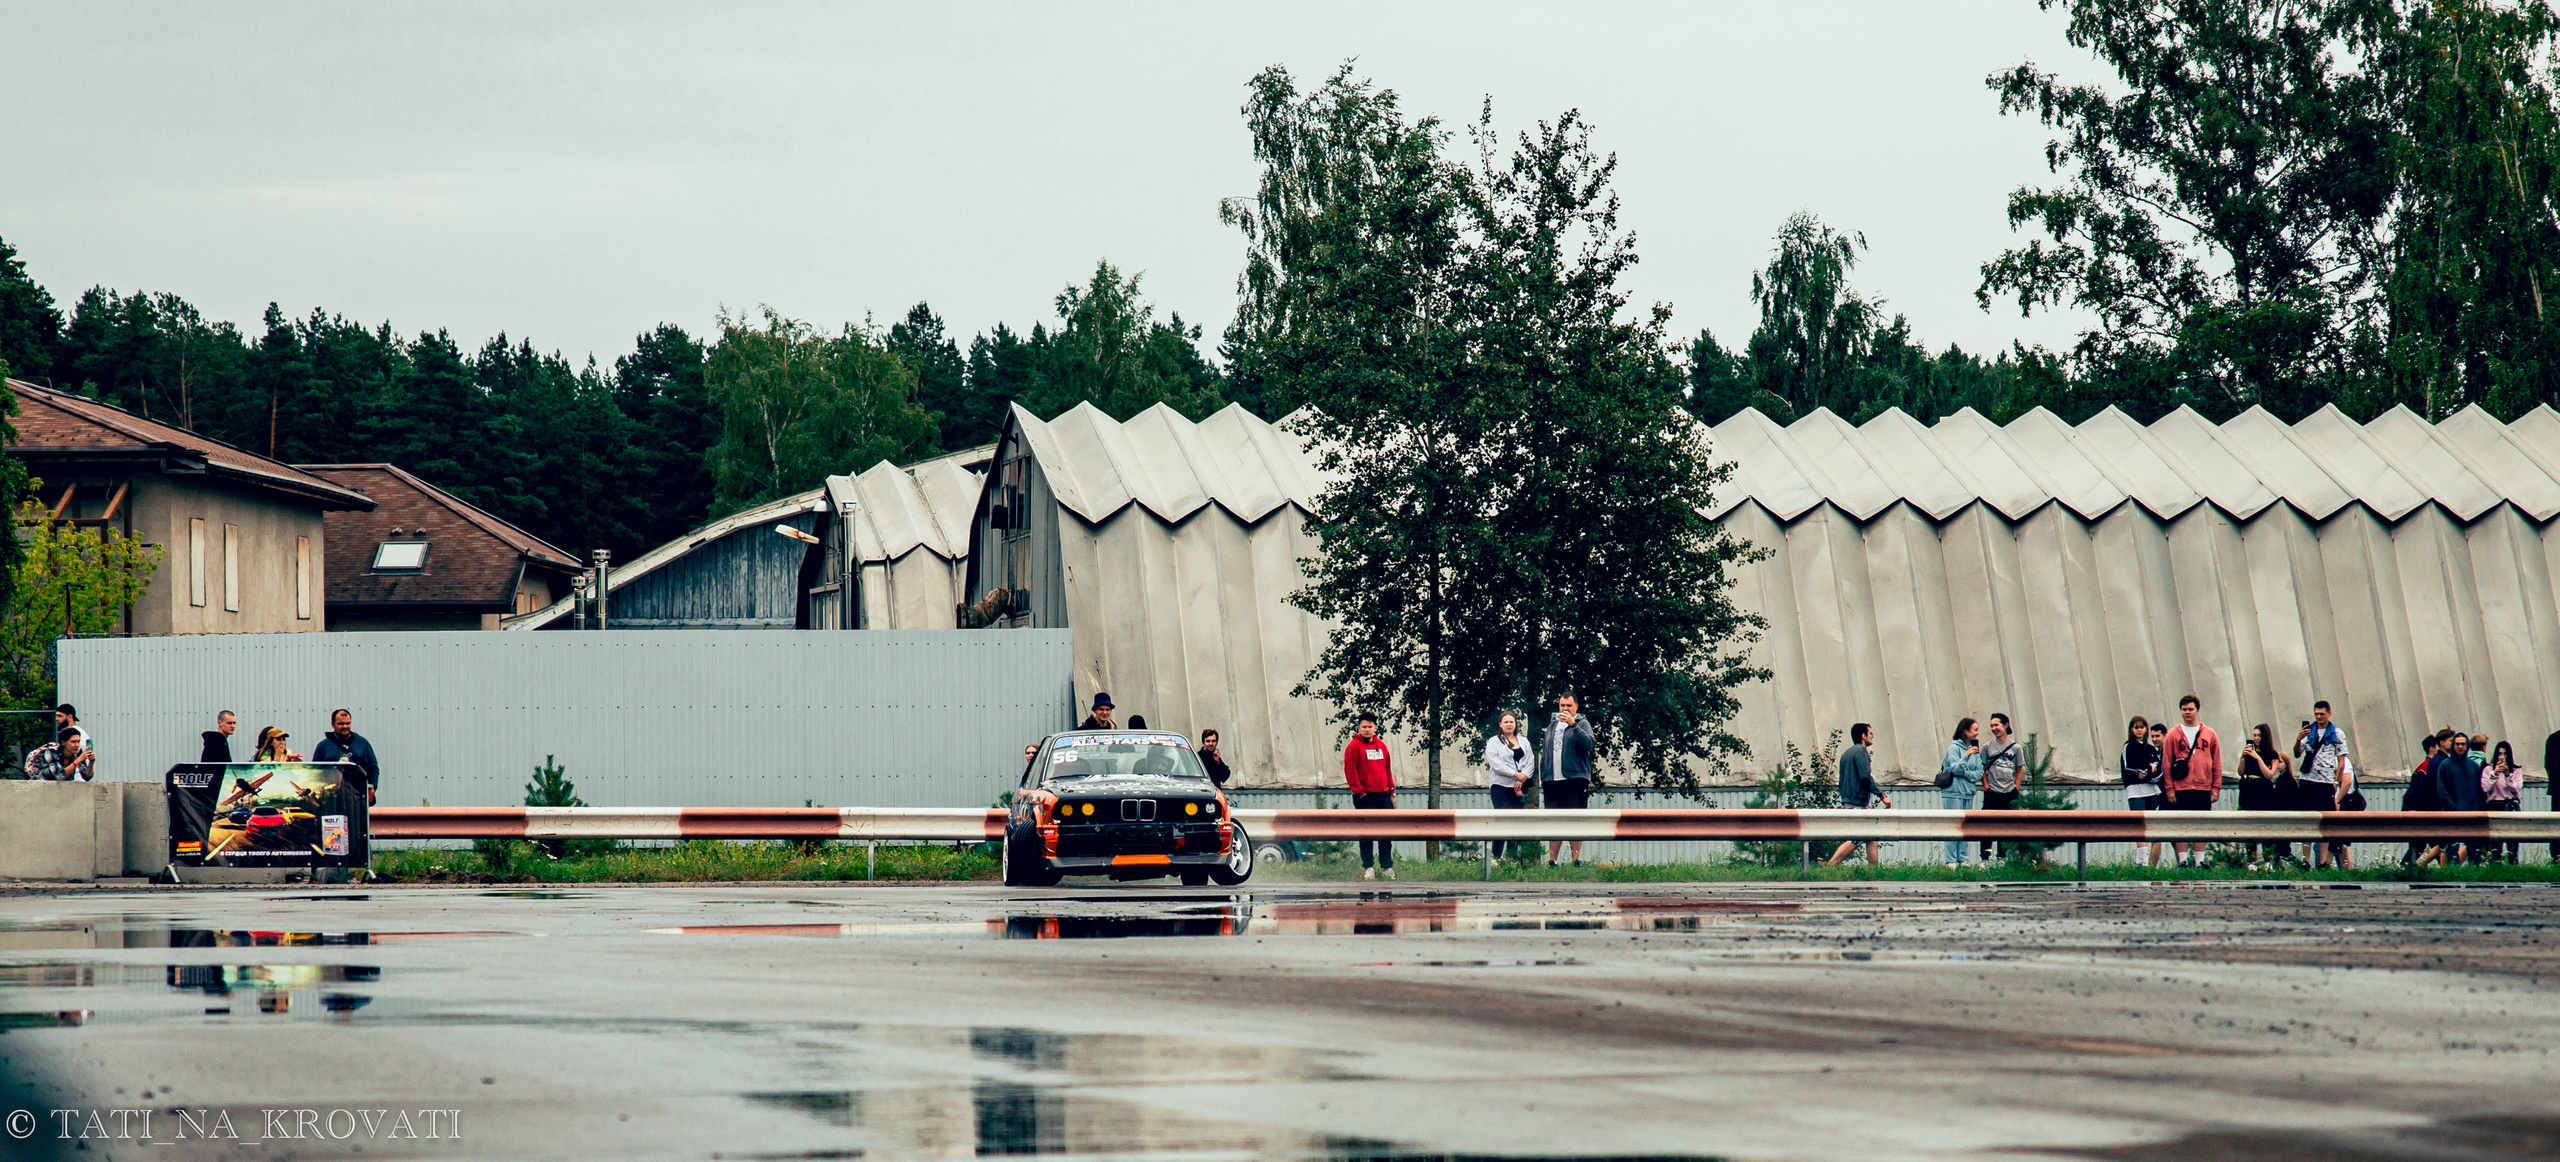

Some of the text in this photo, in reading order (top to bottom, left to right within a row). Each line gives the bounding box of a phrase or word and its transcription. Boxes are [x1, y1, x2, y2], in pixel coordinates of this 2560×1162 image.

[1071, 736, 1150, 747] ALL STARS
[1052, 750, 1079, 764] 56
[176, 773, 214, 784] ROLF
